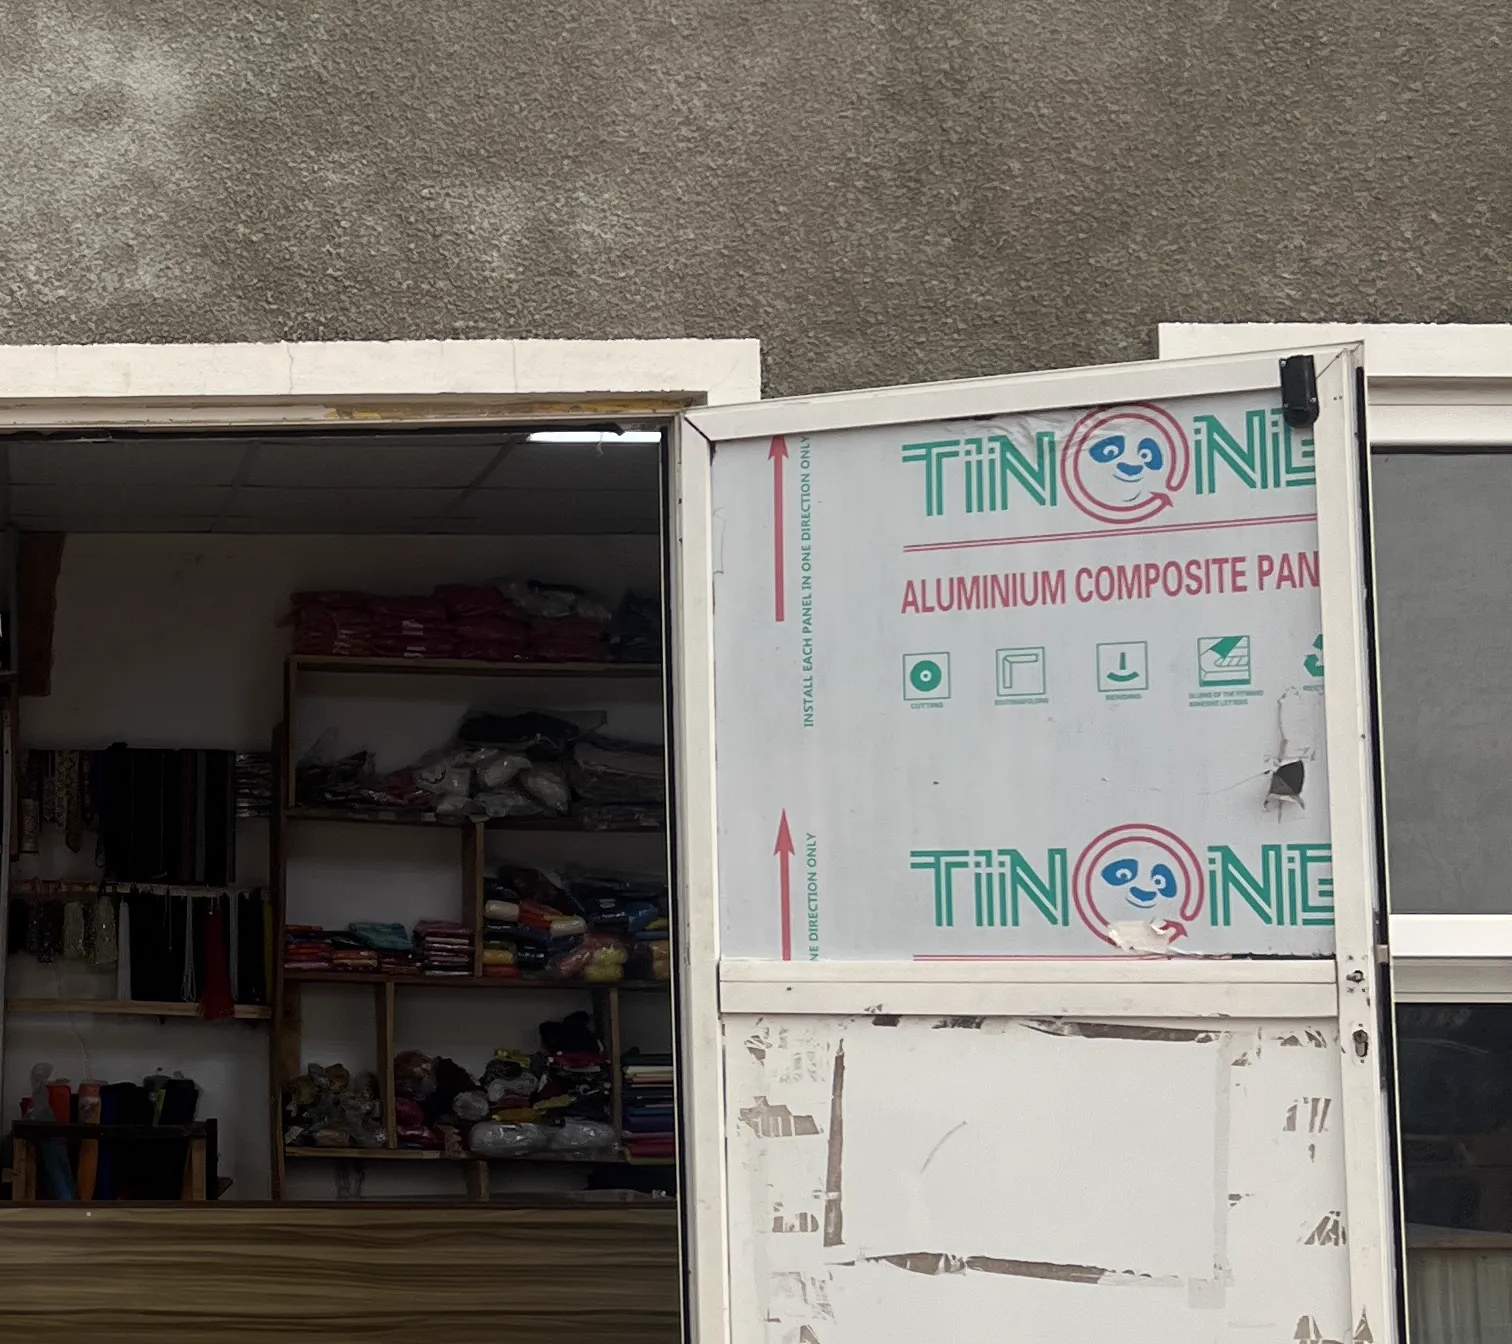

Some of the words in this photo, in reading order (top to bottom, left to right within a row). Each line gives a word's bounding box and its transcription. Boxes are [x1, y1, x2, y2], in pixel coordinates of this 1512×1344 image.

[799, 435, 811, 469] ONLY
[800, 472, 811, 541] DIRECTION
[801, 544, 812, 573] ONE
[801, 575, 812, 591] IN
[901, 569, 1066, 614] ALUMINIUM
[1074, 556, 1248, 603] COMPOSITE
[801, 593, 813, 634] PANEL
[802, 637, 813, 672] EACH
[803, 674, 814, 729] INSTALL
[805, 832, 817, 868] ONLY
[807, 872, 819, 942] DIRECTION
[808, 946, 820, 961] NE
